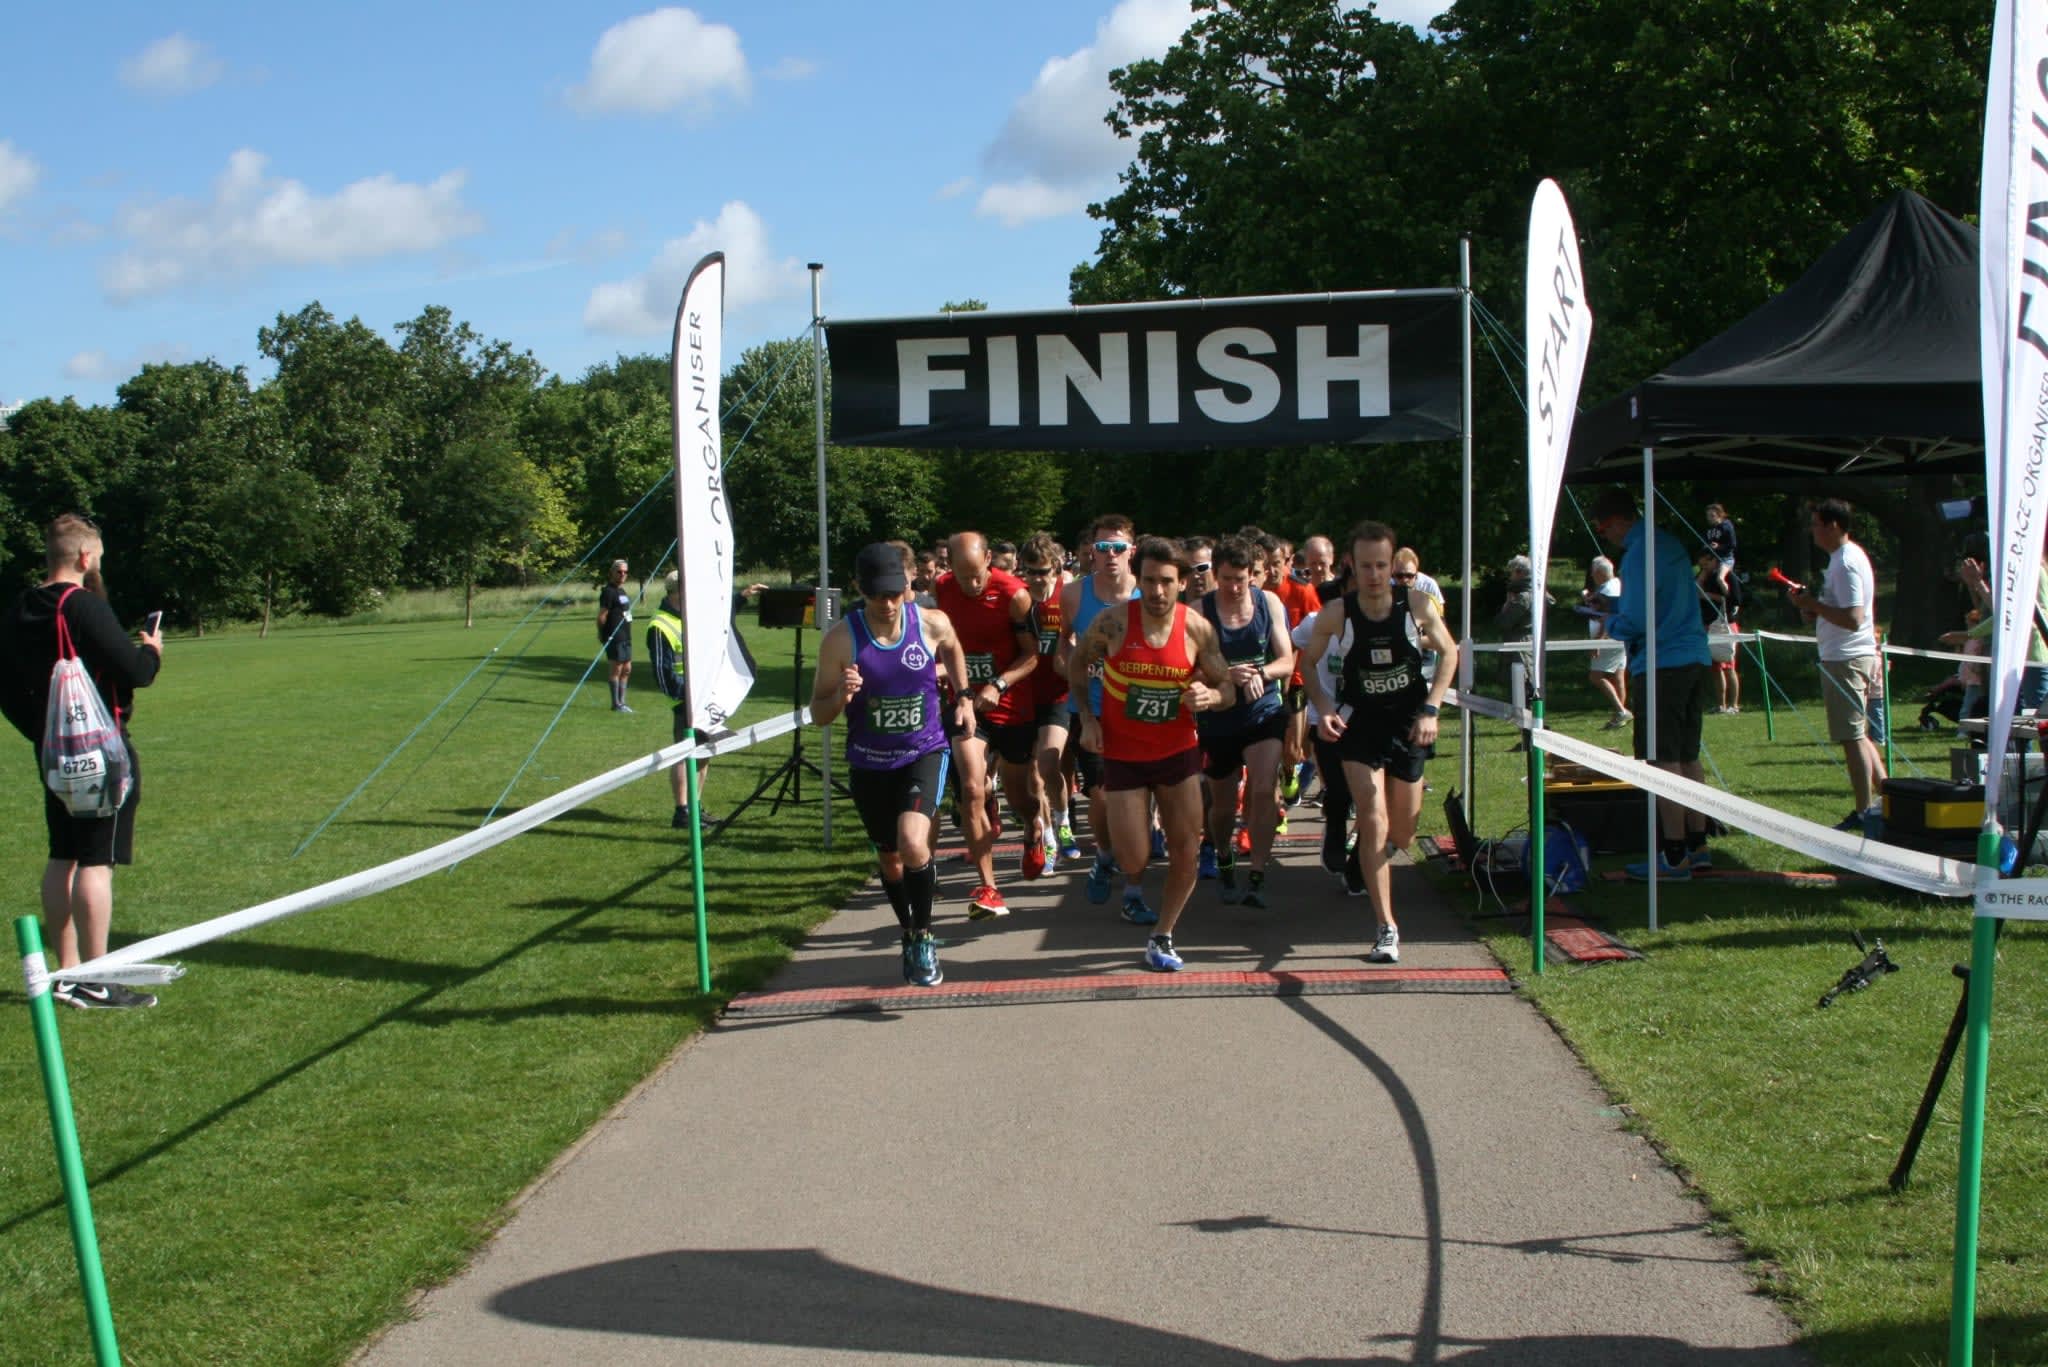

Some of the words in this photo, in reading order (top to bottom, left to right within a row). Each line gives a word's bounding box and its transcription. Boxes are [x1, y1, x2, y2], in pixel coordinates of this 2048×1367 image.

[1537, 227, 1578, 447] START
[895, 323, 1391, 427] FINISH
[689, 311, 721, 525] ORGANISER
[1119, 661, 1190, 679] SERPENTINE
[1363, 673, 1410, 694] 9509
[872, 706, 922, 728] 1236
[1136, 698, 1170, 717] 731
[63, 758, 97, 776] 6725
[1999, 893, 2025, 905] THE
